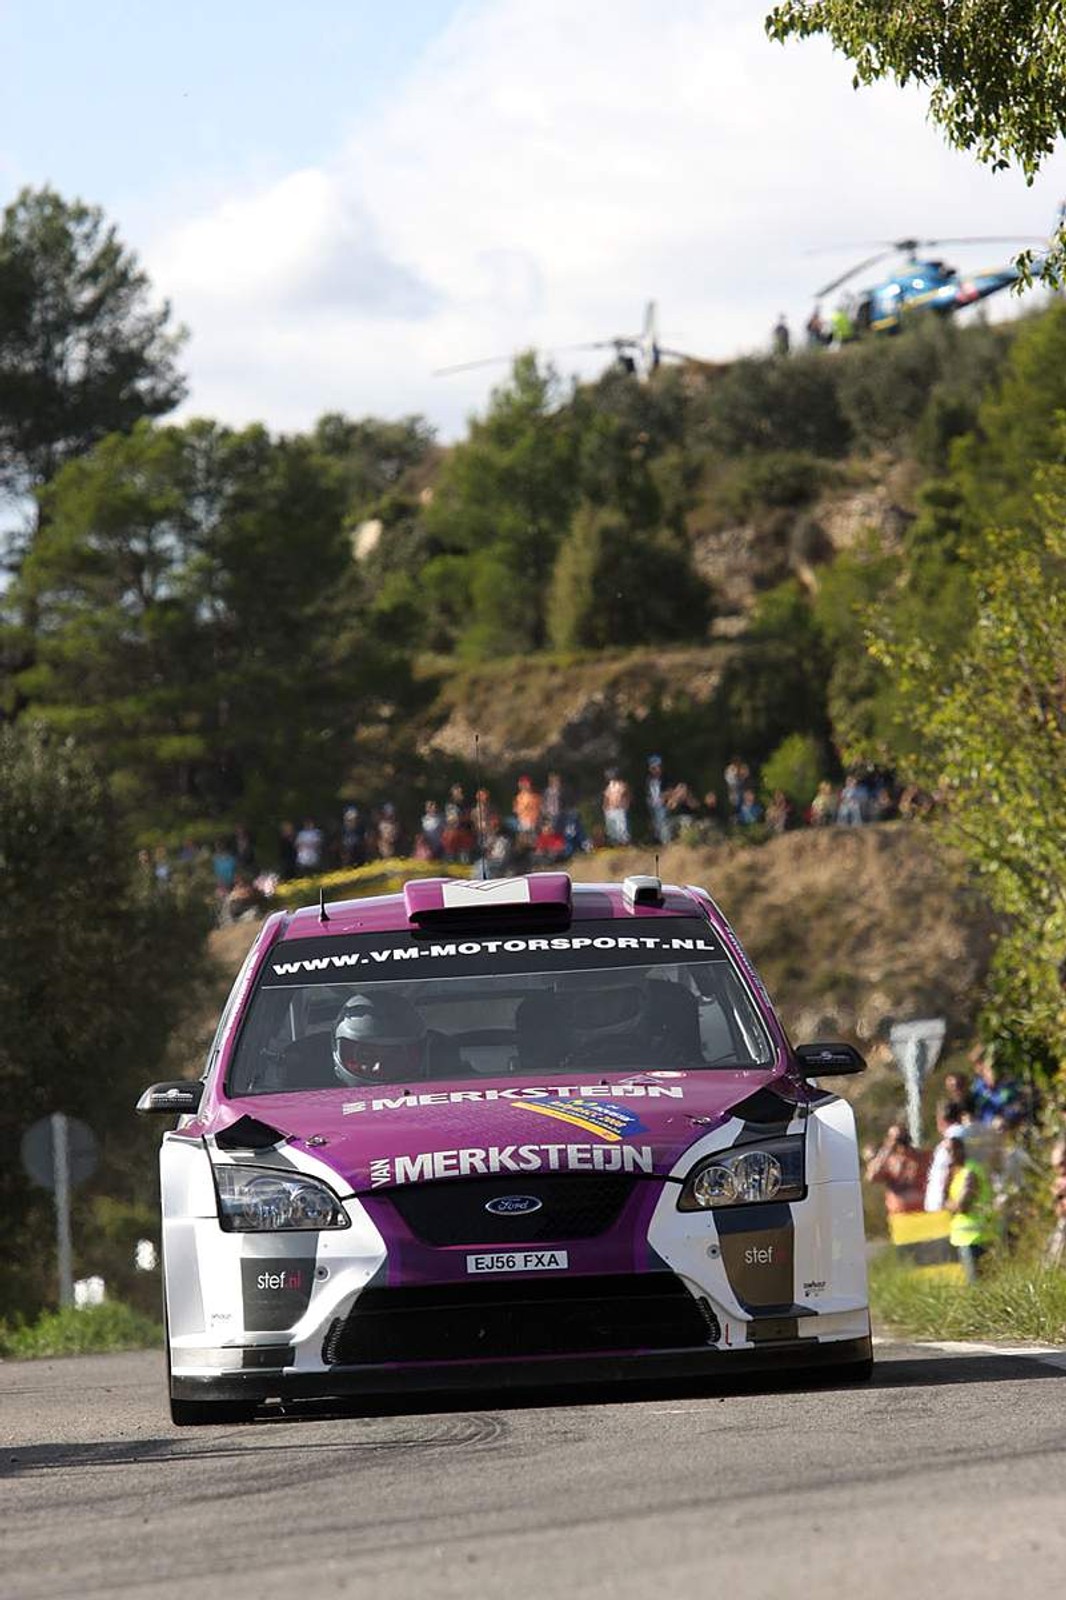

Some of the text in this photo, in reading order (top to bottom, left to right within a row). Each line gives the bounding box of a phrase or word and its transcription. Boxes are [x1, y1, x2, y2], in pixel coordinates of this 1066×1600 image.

[272, 937, 715, 975] WWW.VM-MOTORSPORT.NL
[370, 1158, 391, 1188] VAN
[498, 1199, 530, 1211] Ford
[474, 1253, 560, 1271] EJ56 FXA
